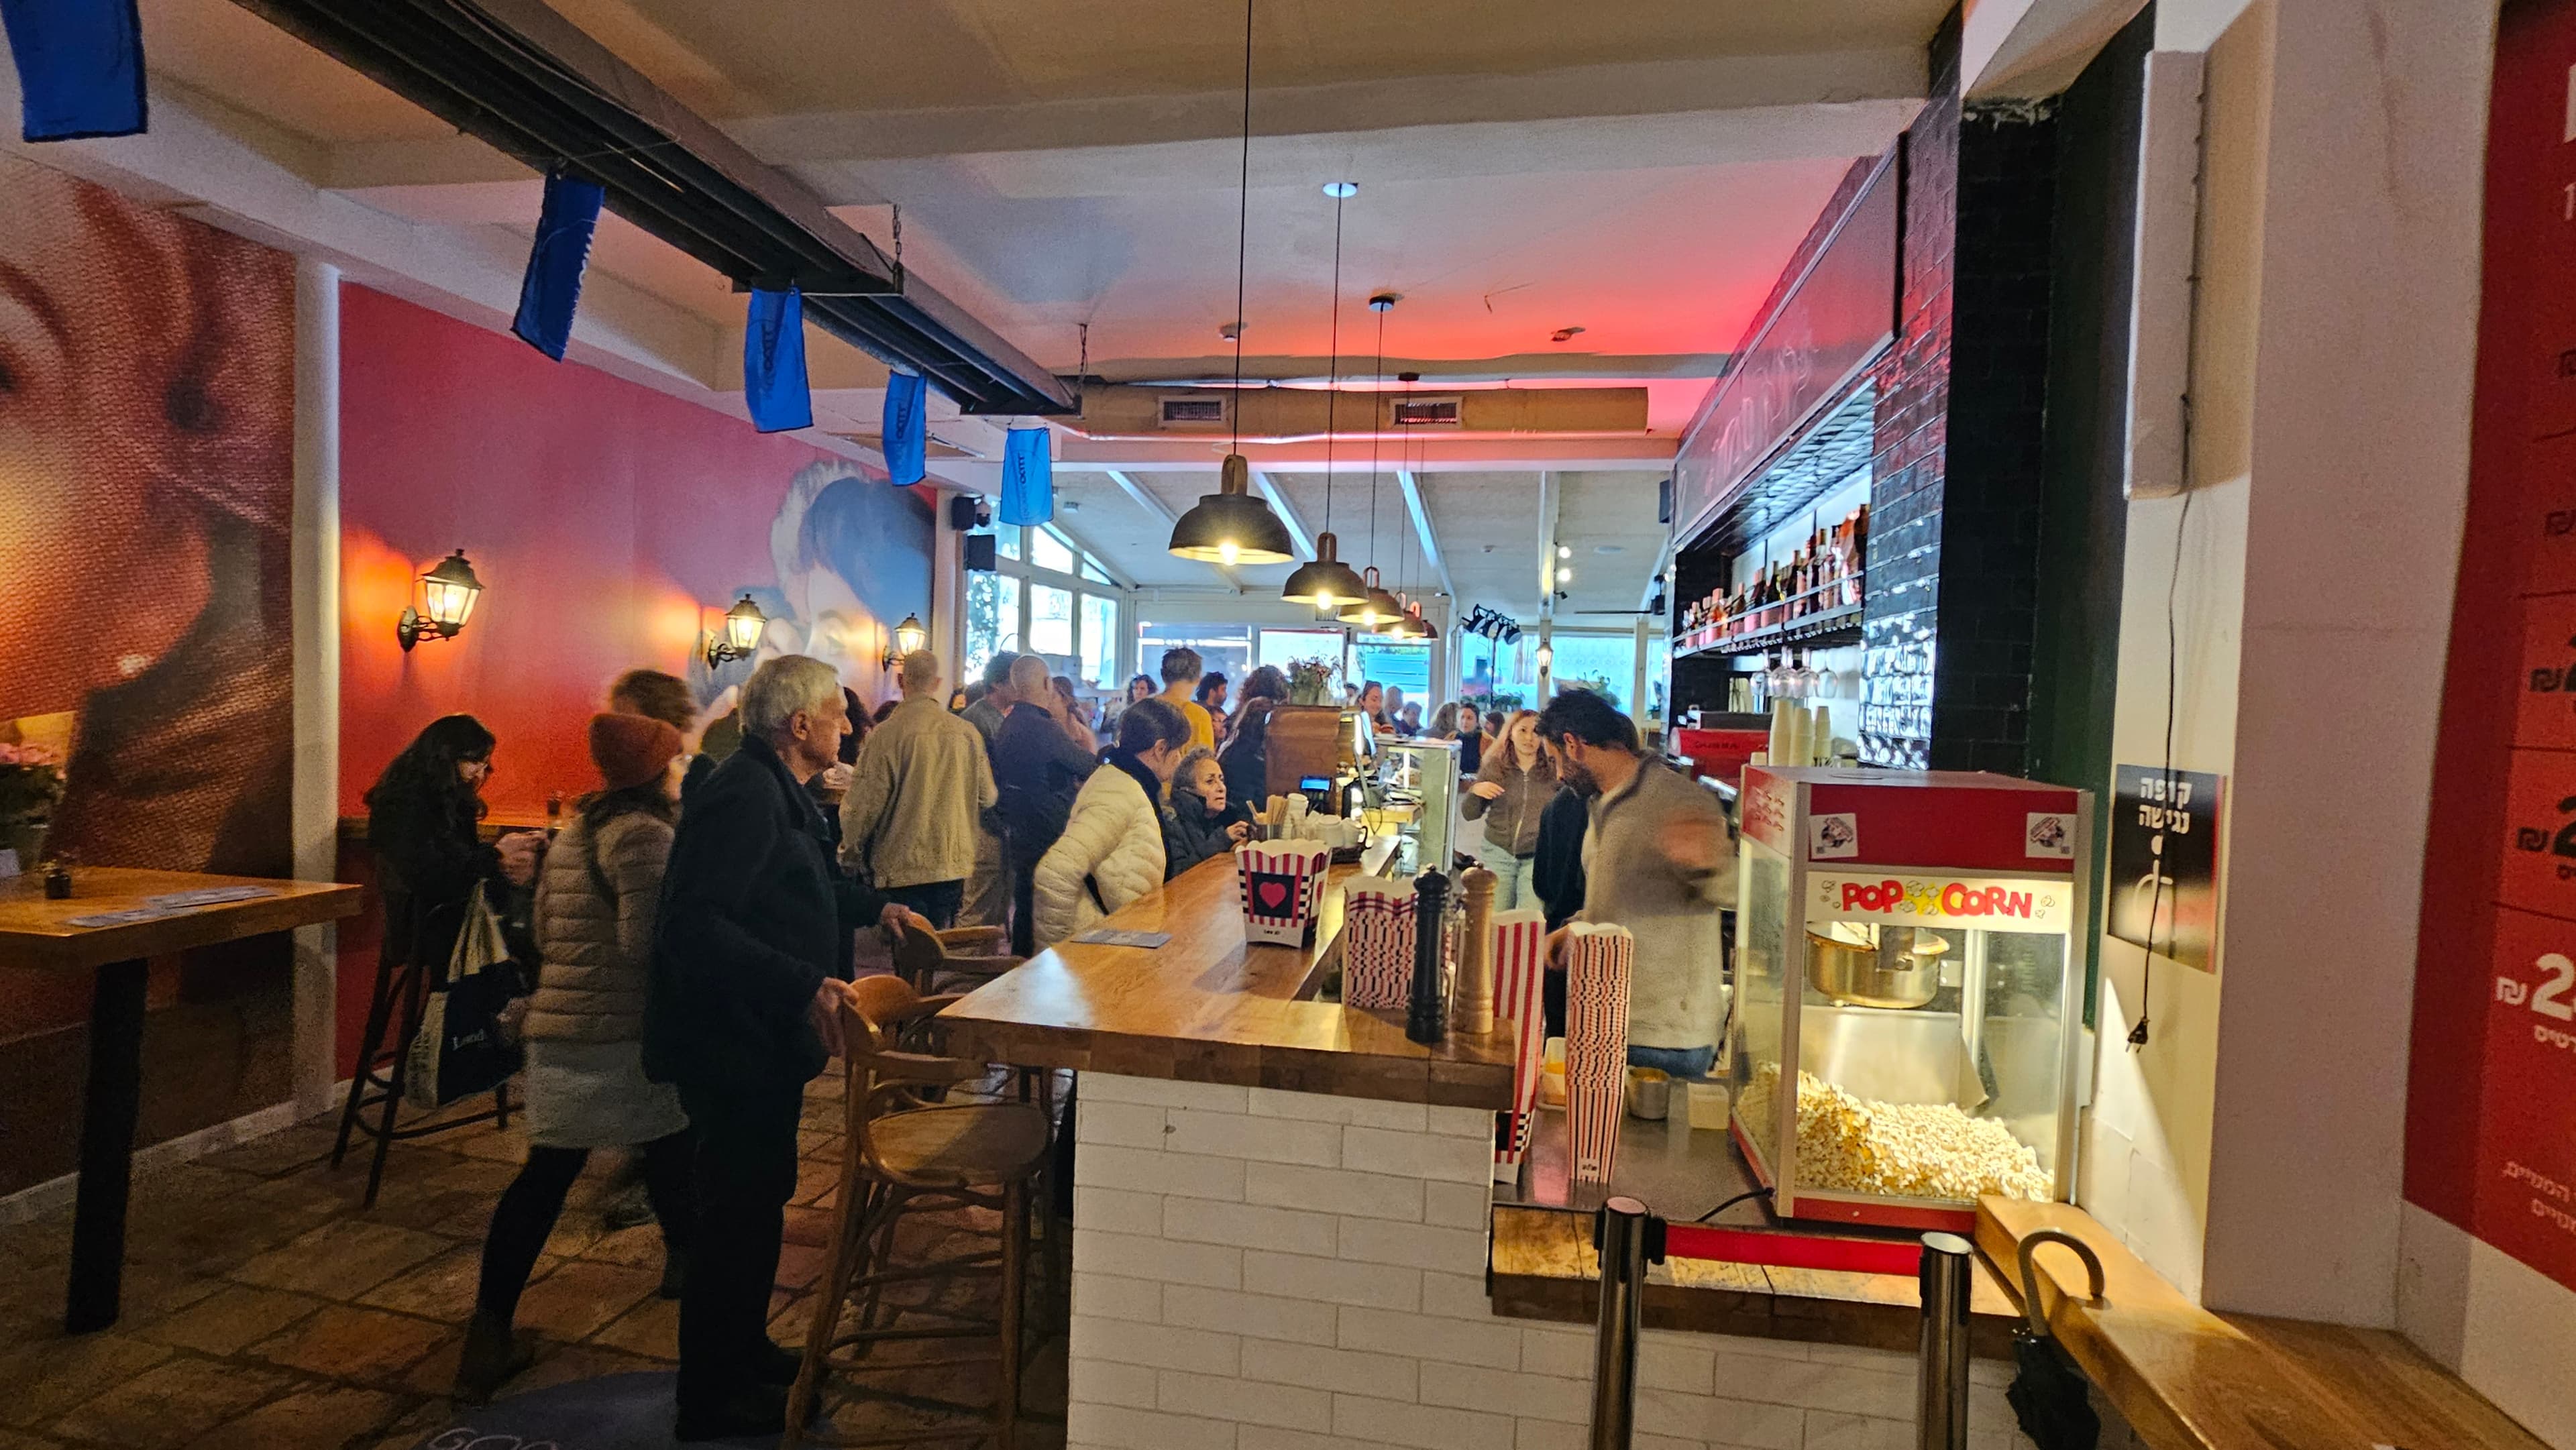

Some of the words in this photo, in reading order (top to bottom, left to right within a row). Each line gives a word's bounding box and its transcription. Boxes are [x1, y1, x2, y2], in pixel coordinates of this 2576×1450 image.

[2140, 777, 2192, 810] קופה
[2139, 804, 2190, 835] נגישה
[1841, 880, 1904, 913] POP
[1941, 882, 2033, 919] CORN
